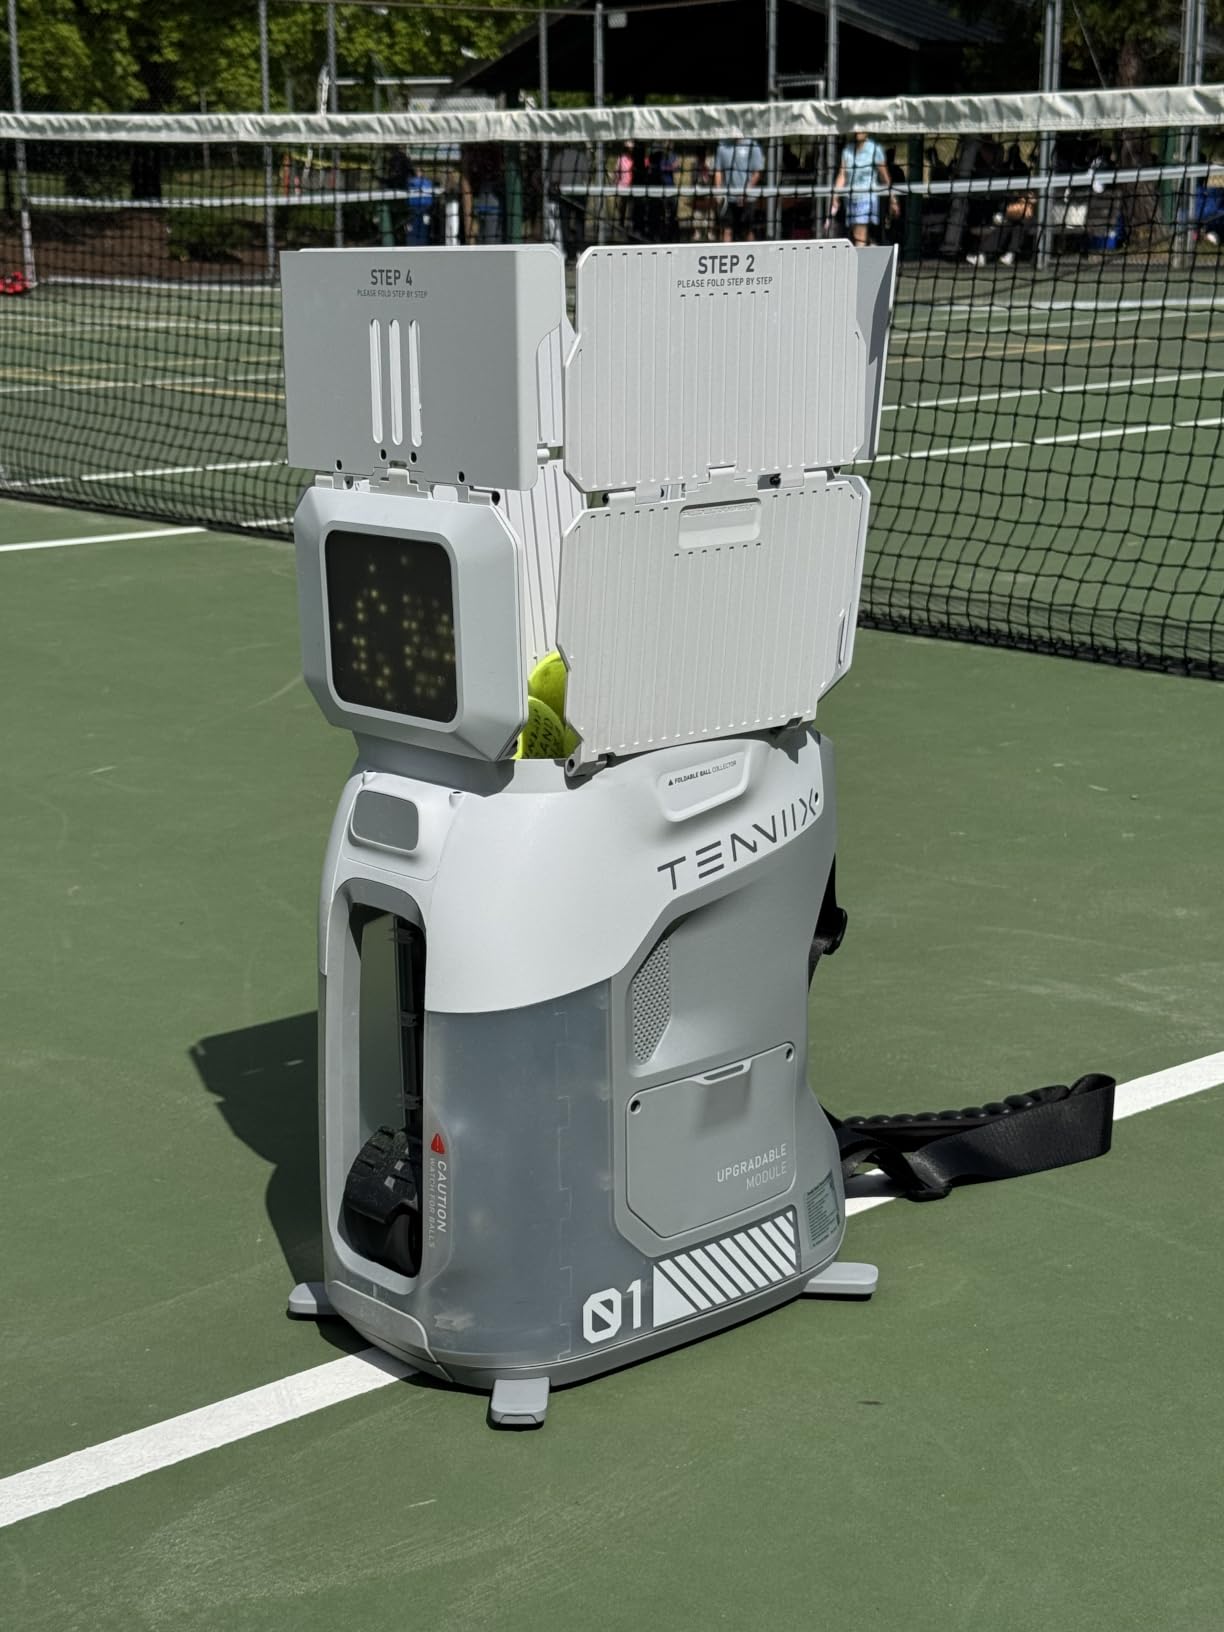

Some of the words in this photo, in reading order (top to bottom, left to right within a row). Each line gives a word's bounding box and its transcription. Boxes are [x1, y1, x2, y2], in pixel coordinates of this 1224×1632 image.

[698, 254, 740, 274] STEP
[745, 253, 755, 273] 2
[370, 268, 401, 286] STEP
[405, 268, 413, 286] 4
[677, 279, 705, 288] PLEASE
[706, 278, 725, 287] FOLD
[727, 277, 744, 287] STEP
[745, 276, 755, 286] BY
[756, 276, 773, 285] STEP
[357, 288, 377, 297] PLEASE
[377, 289, 391, 298] FOLD
[392, 289, 405, 298] STEP
[406, 290, 413, 298] BY
[414, 290, 428, 299] STEP
[674, 771, 699, 785] FOLDABLE
[699, 768, 712, 777] BALL
[711, 760, 737, 773] COLLECTOR
[717, 1143, 787, 1183] UPGRADABLE
[746, 1160, 788, 1191] MODULE
[428, 1193, 436, 1214] FOR
[437, 1160, 447, 1233] CAUTION
[428, 1215, 436, 1249] BALLS
[583, 1278, 642, 1344] 01
